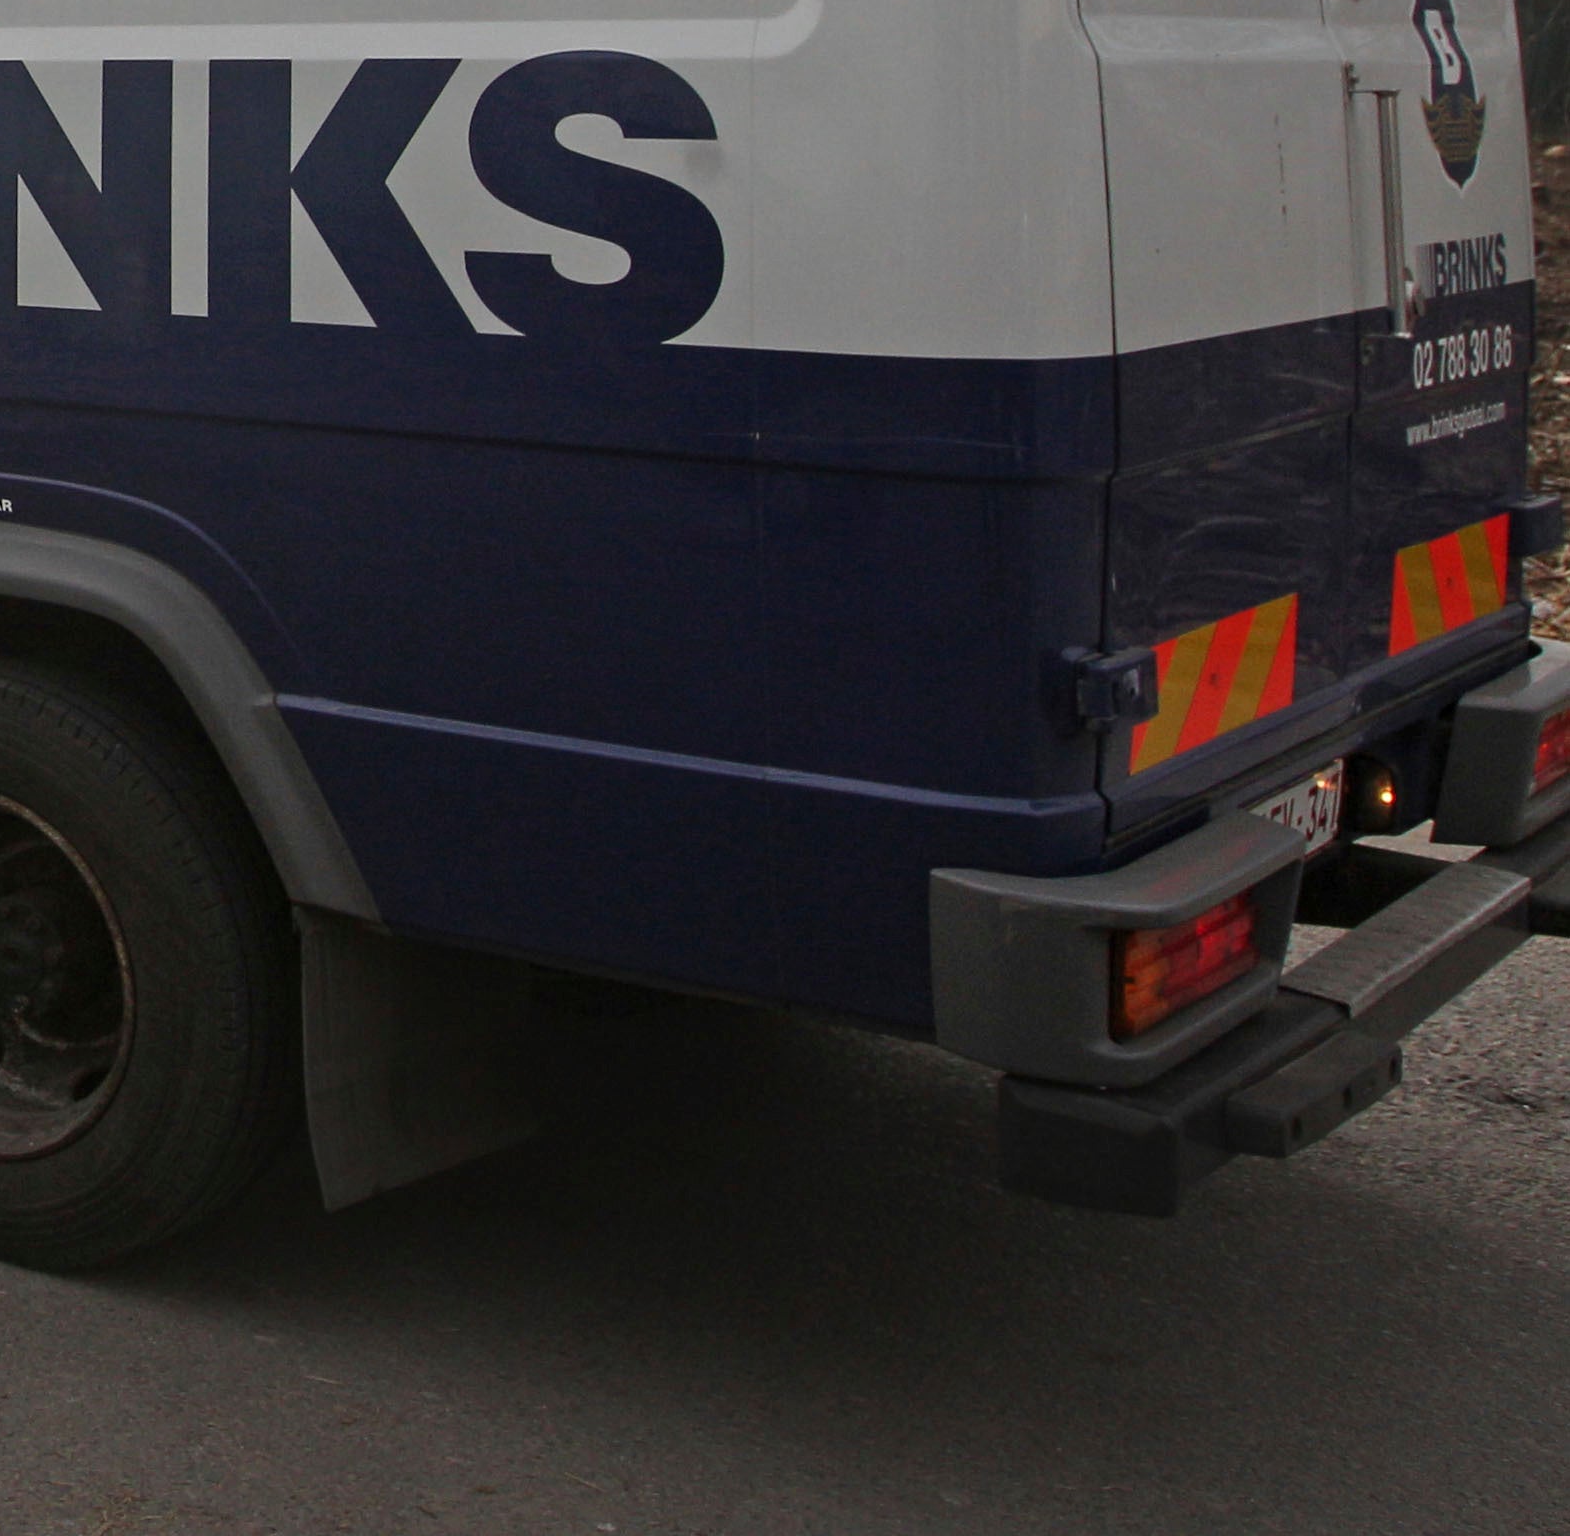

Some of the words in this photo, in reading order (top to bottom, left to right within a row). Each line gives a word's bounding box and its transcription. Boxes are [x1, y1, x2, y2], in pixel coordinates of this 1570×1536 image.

[1423, 9, 1462, 85] B
[1433, 233, 1508, 297] BRINKS
[1413, 340, 1434, 389] 02
[1470, 328, 1489, 378] 30
[1493, 324, 1512, 369] 86
